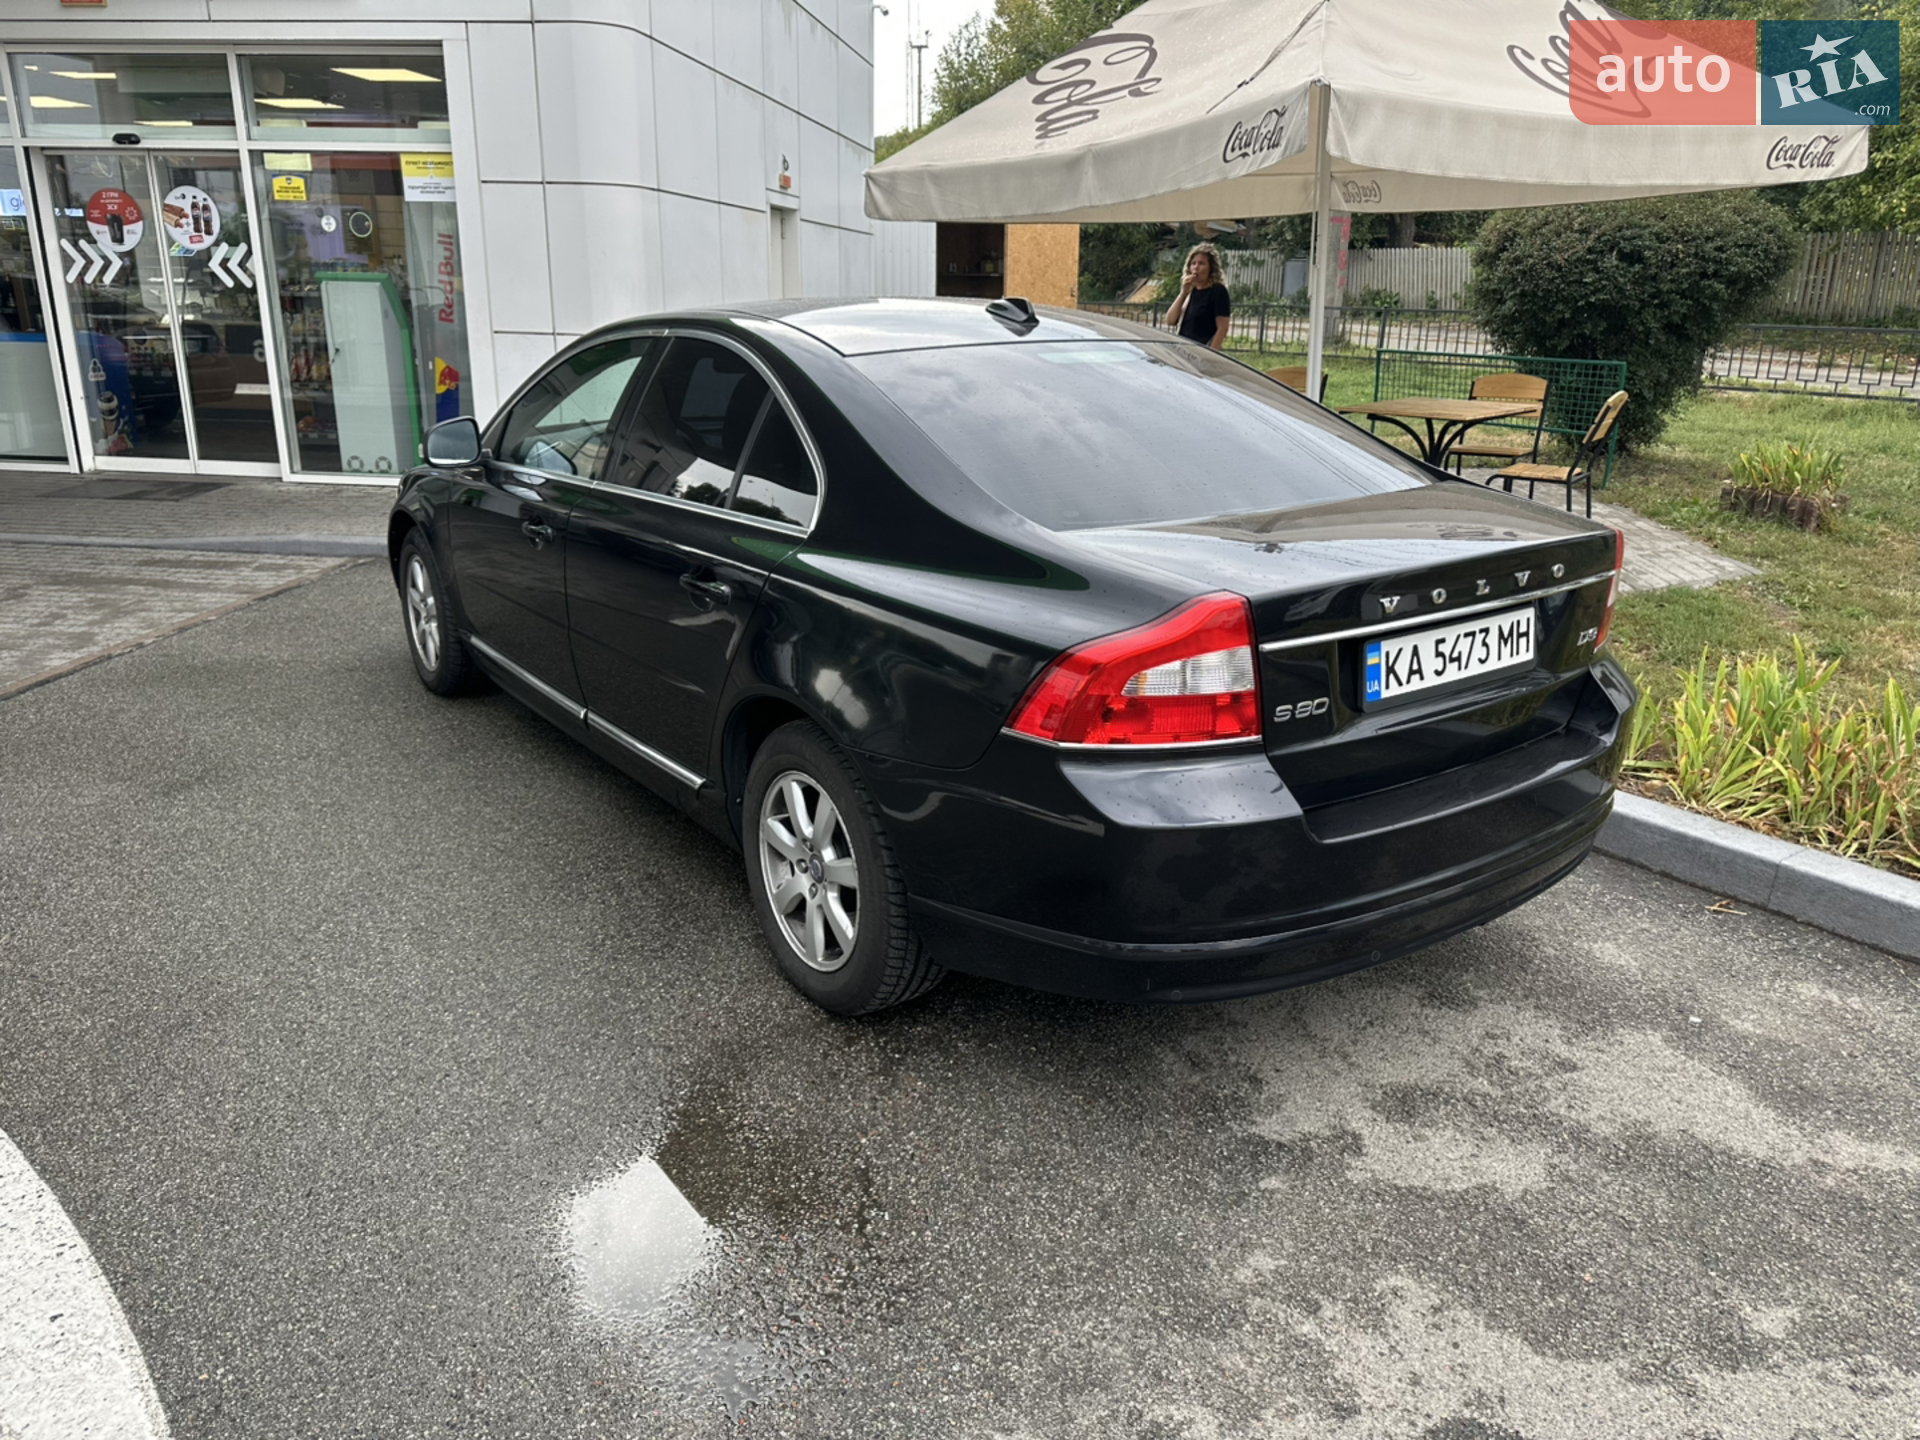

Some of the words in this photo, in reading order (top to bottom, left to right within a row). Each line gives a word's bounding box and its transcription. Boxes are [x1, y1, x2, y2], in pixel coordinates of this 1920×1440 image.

[1766, 135, 1843, 170] Coca-Cola
[1380, 563, 1565, 613] VOLVO
[1385, 644, 1424, 690] KA
[1433, 626, 1491, 676] 5473
[1497, 617, 1531, 661] MH
[1366, 680, 1380, 693] UA
[1273, 697, 1329, 722] S80
